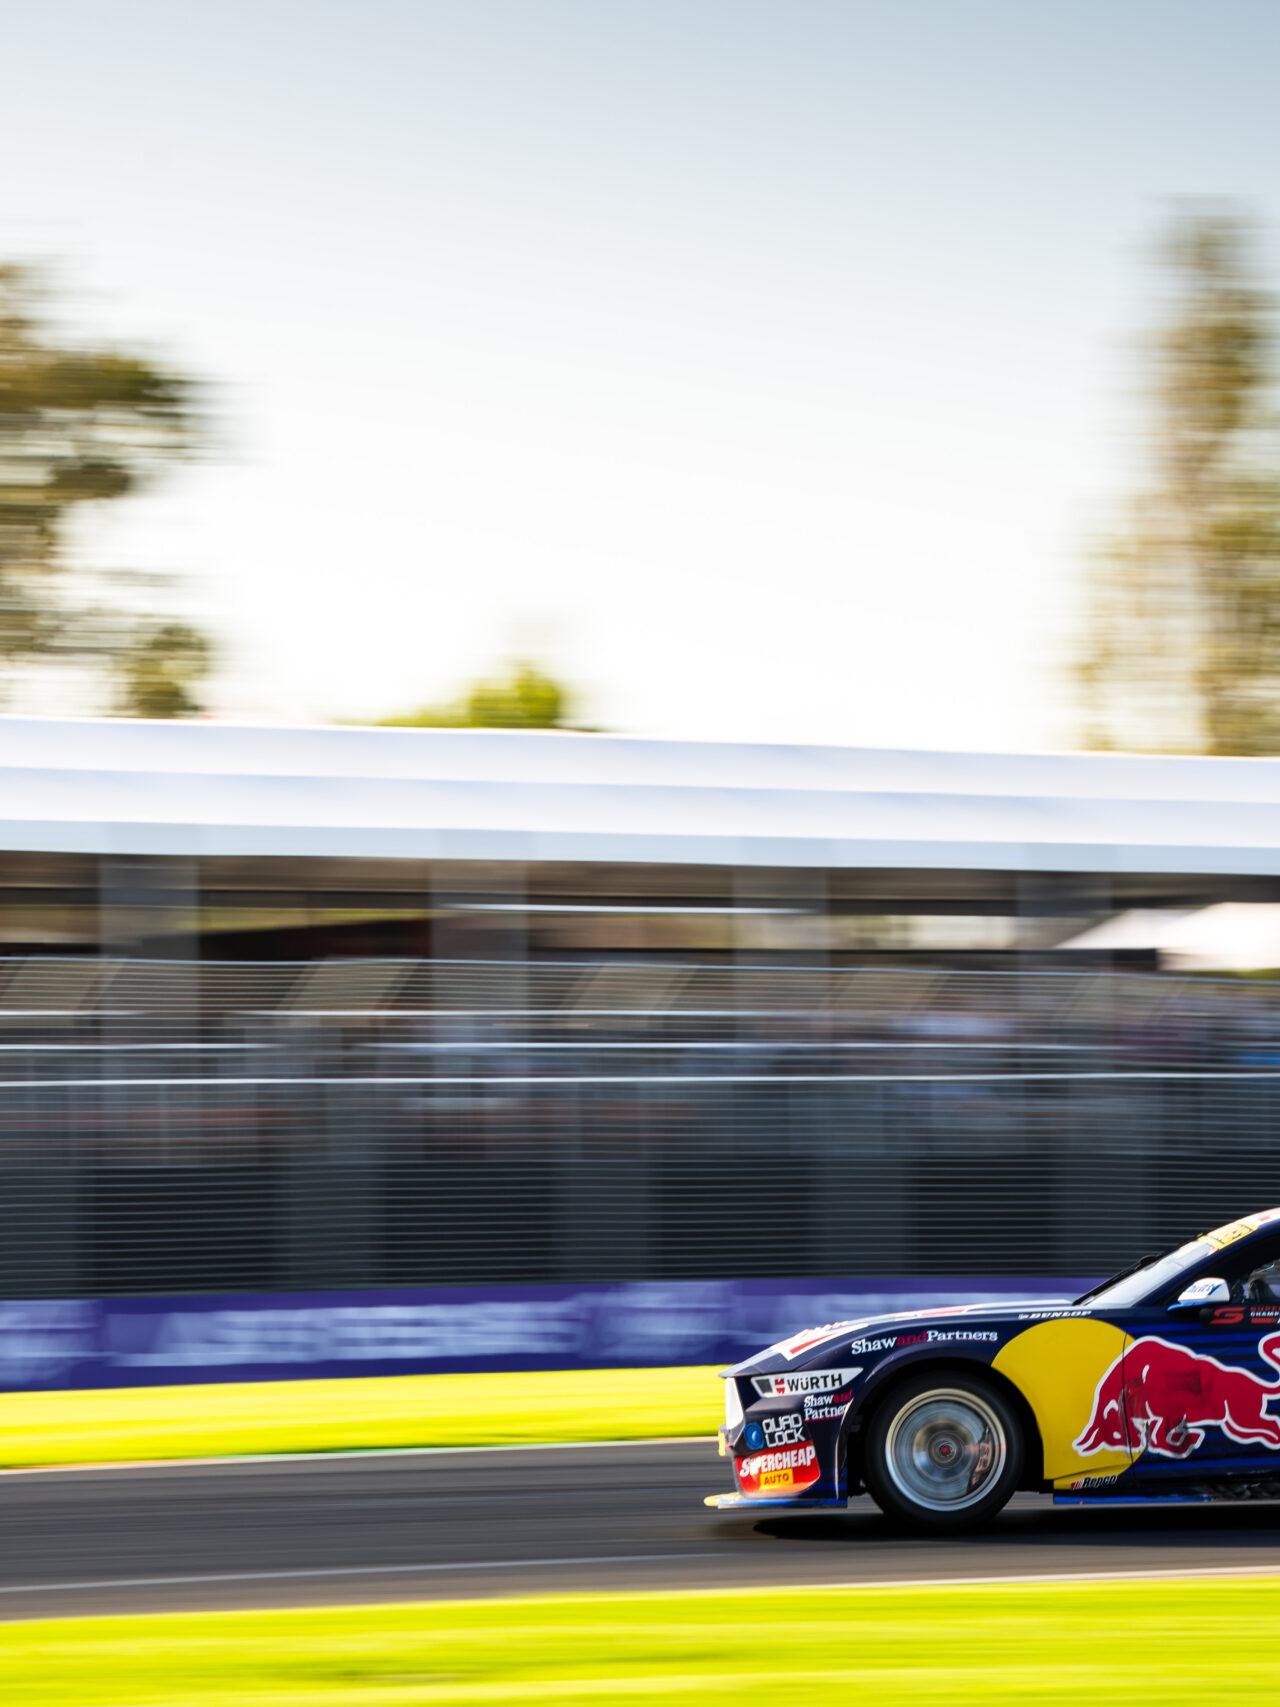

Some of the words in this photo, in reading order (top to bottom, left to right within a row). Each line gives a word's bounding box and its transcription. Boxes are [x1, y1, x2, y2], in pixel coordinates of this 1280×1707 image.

[1029, 1310, 1093, 1319] DUNLOP
[804, 1403, 849, 1421] Partner
[762, 1413, 802, 1433] QUAD
[765, 1427, 806, 1448] LOCK
[739, 1445, 816, 1477] SUPERCHEAP
[764, 1472, 790, 1485] AUTO
